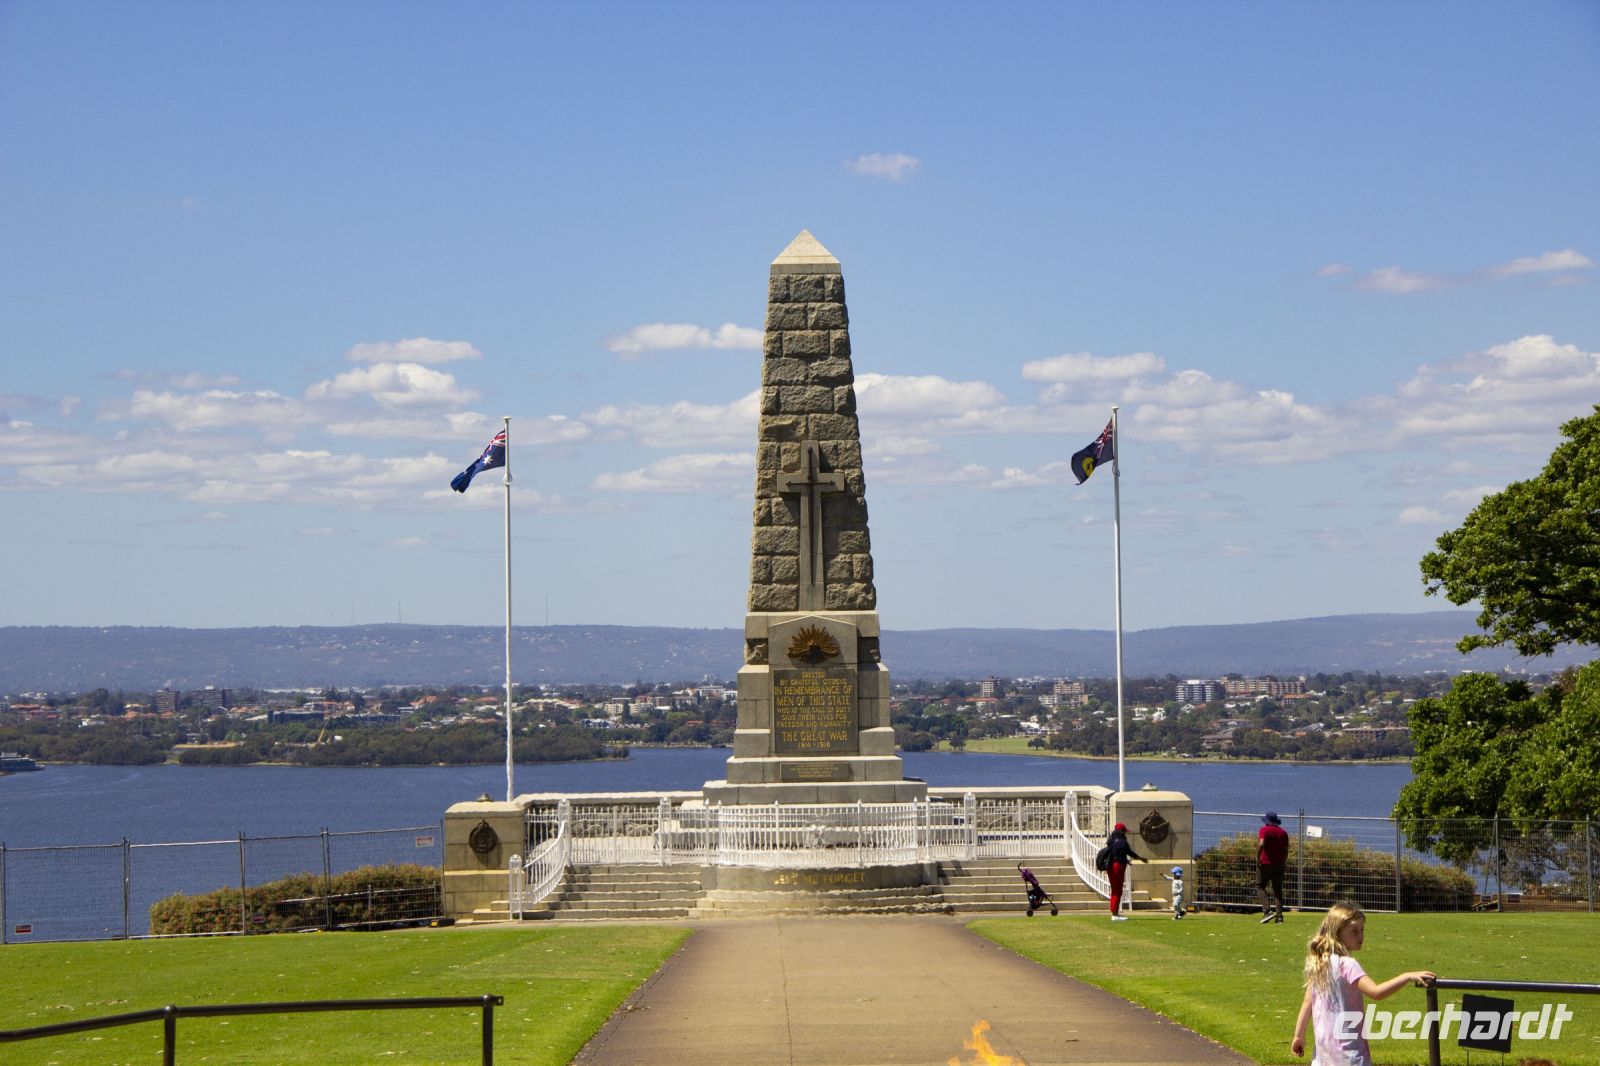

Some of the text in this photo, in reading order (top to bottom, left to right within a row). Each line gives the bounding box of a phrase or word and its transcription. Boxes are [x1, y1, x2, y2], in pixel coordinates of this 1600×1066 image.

[774, 685, 853, 695] IN REMEMBRANCE OF
[776, 696, 851, 706] MEN OF THIS STATE
[783, 731, 848, 742] THE GREAT WAR
[823, 872, 865, 883] FORGET
